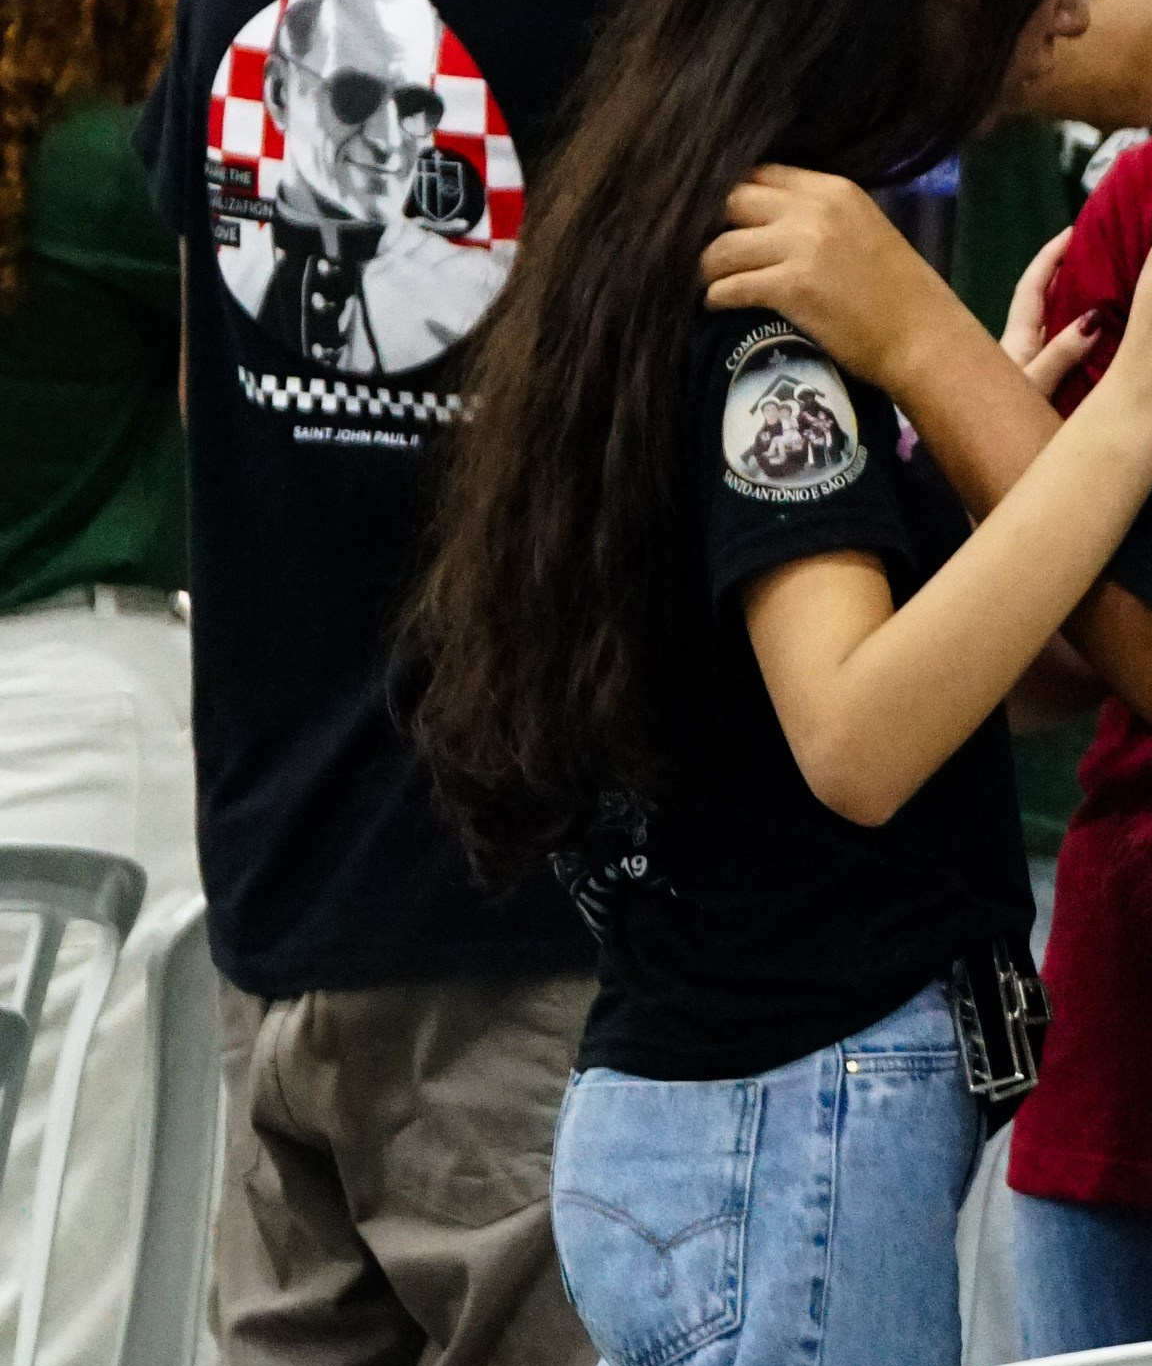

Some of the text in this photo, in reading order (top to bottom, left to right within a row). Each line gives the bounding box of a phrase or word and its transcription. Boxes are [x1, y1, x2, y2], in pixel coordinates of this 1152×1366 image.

[293, 426, 333, 443] SAINT
[335, 428, 373, 446] JOHN
[374, 430, 409, 447] PAUL
